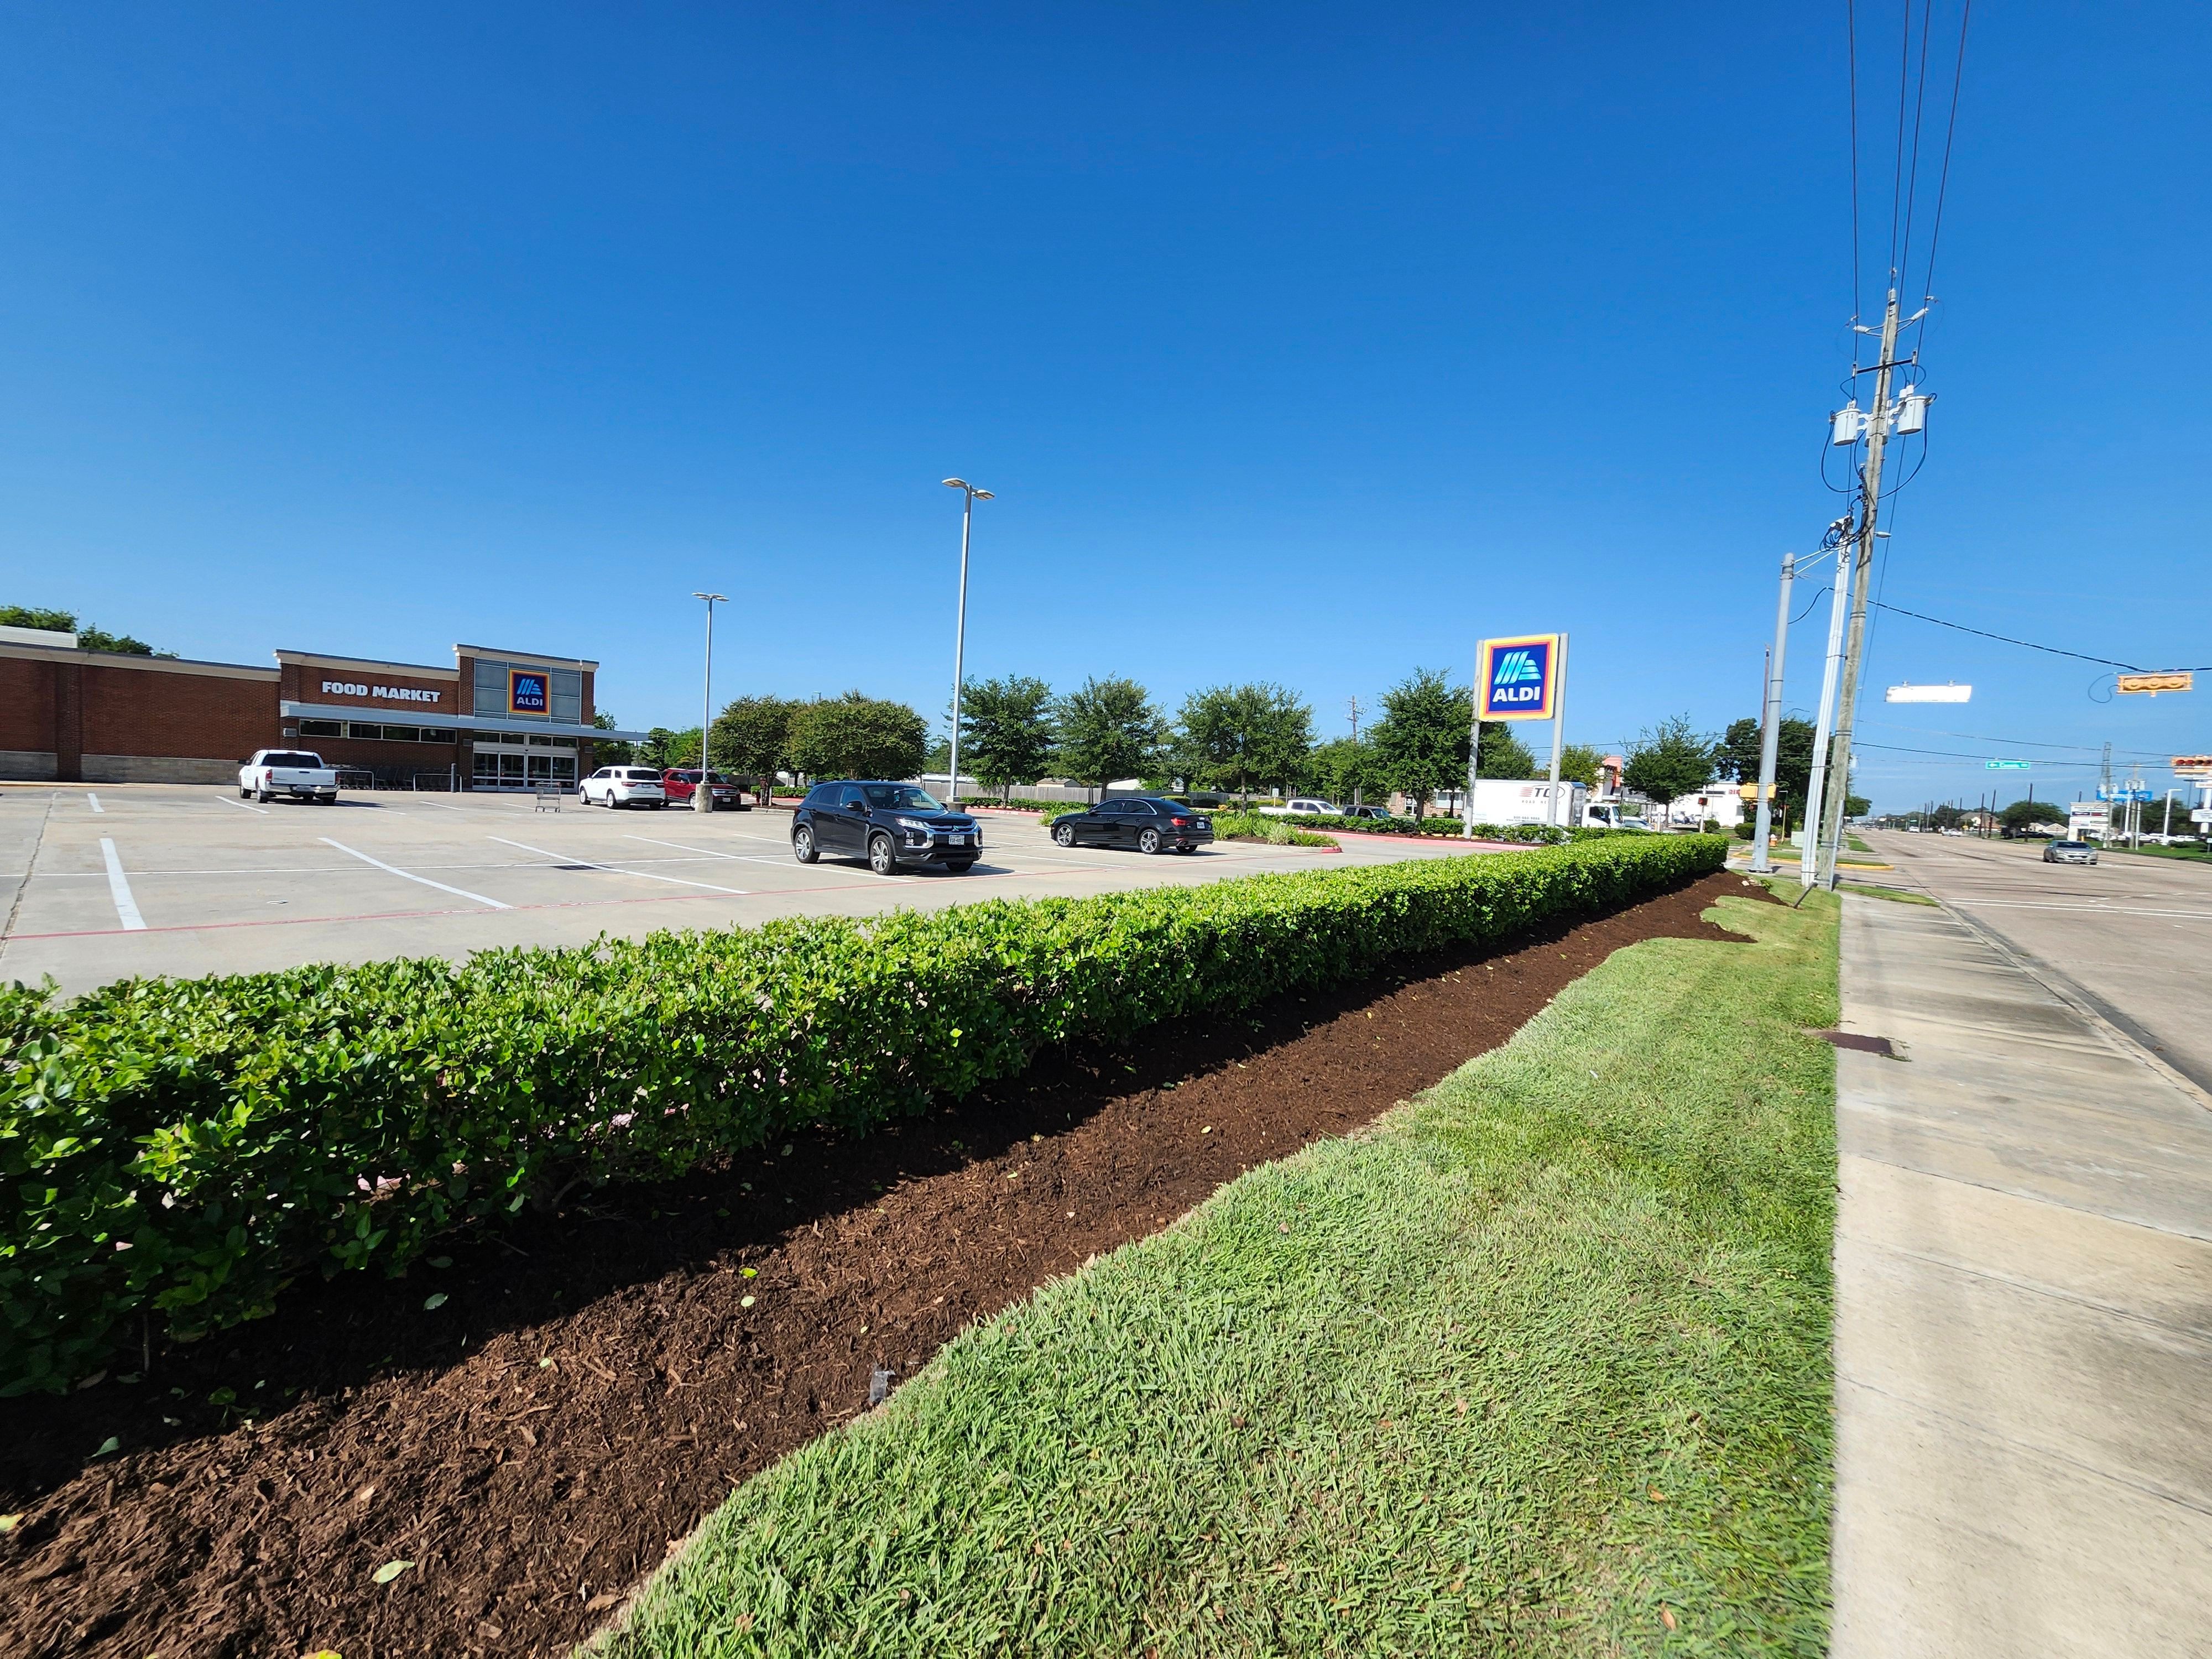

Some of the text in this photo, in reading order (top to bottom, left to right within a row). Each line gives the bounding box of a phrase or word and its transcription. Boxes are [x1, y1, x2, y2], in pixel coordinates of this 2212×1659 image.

[322, 681, 441, 702] FOOD MARKET
[1492, 686, 1541, 702] ALDI
[517, 697, 543, 706] ALDI
[1535, 787, 1559, 797] TC
